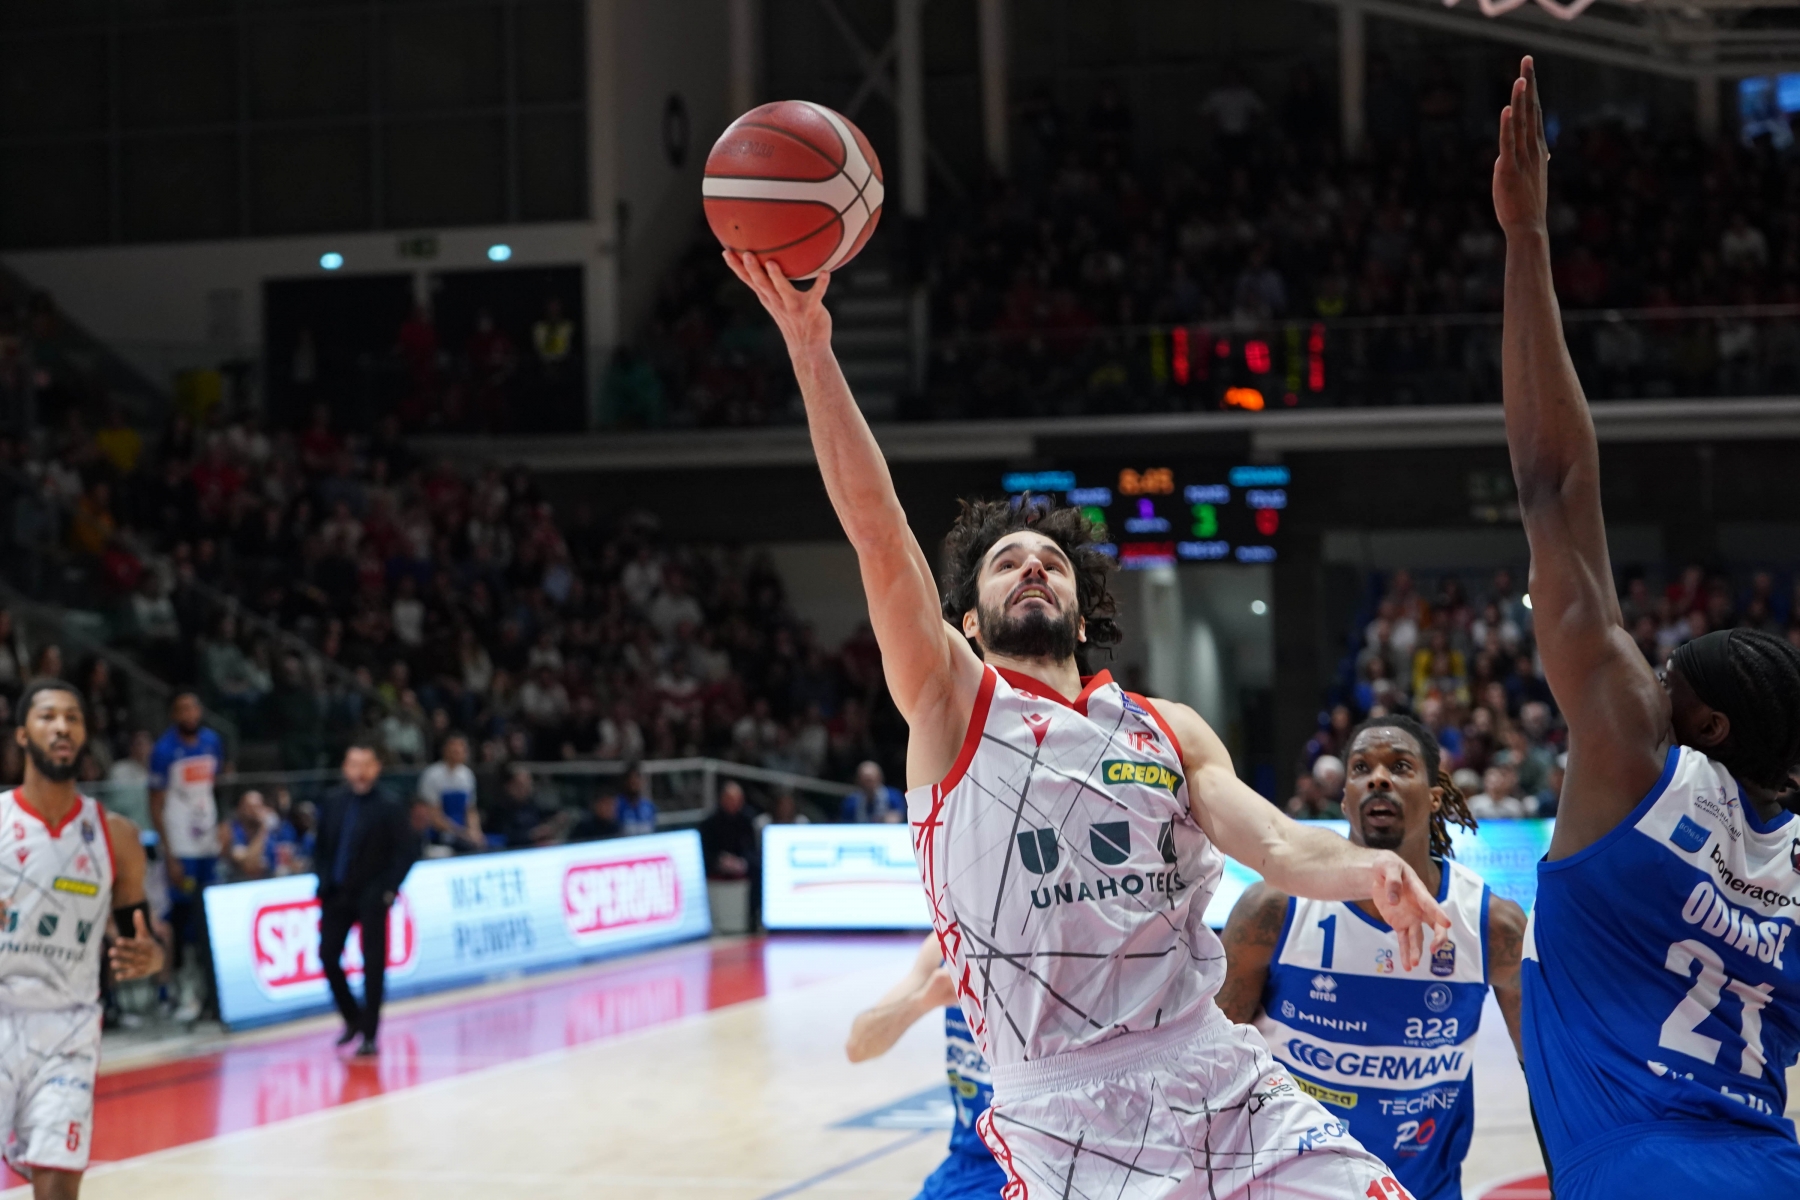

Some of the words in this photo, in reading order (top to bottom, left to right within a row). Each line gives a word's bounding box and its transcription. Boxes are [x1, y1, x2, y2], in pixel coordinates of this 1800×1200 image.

[1031, 872, 1187, 909] UNAHOTELS
[257, 899, 408, 980] SPEI
[1317, 914, 1337, 970] 1
[1682, 881, 1792, 970] ODIASE
[1298, 1010, 1368, 1032] MININI
[1658, 939, 1775, 1079] 21
[1404, 1017, 1459, 1039] a2a
[1335, 1052, 1464, 1080] GERMANI
[66, 1120, 81, 1152] 5
